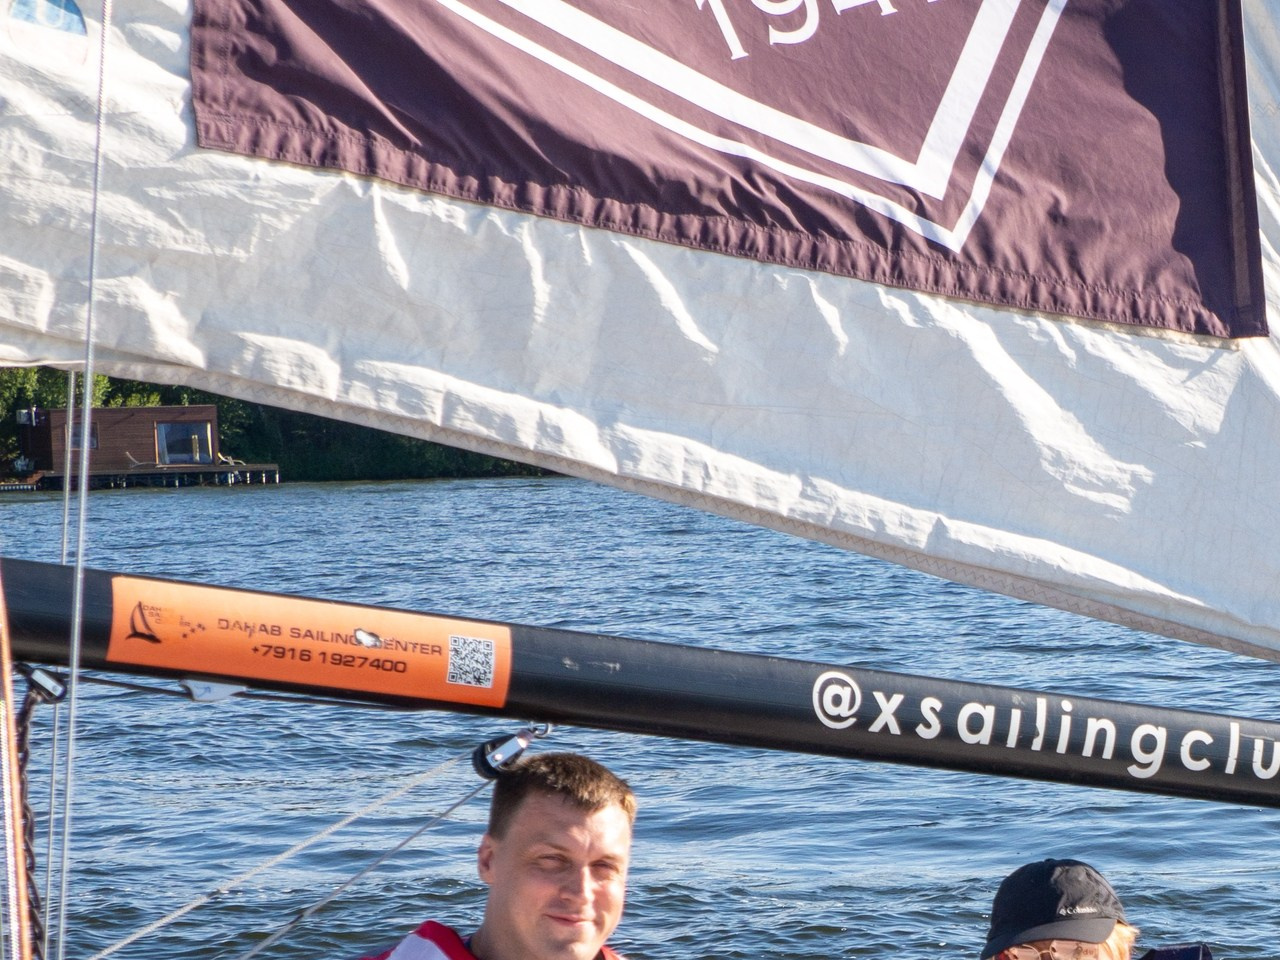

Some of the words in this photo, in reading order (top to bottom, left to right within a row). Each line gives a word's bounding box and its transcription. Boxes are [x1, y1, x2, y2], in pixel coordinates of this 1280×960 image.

[251, 644, 312, 662] +7916
[318, 651, 407, 673] 1927400
[373, 638, 442, 656] ENTER
